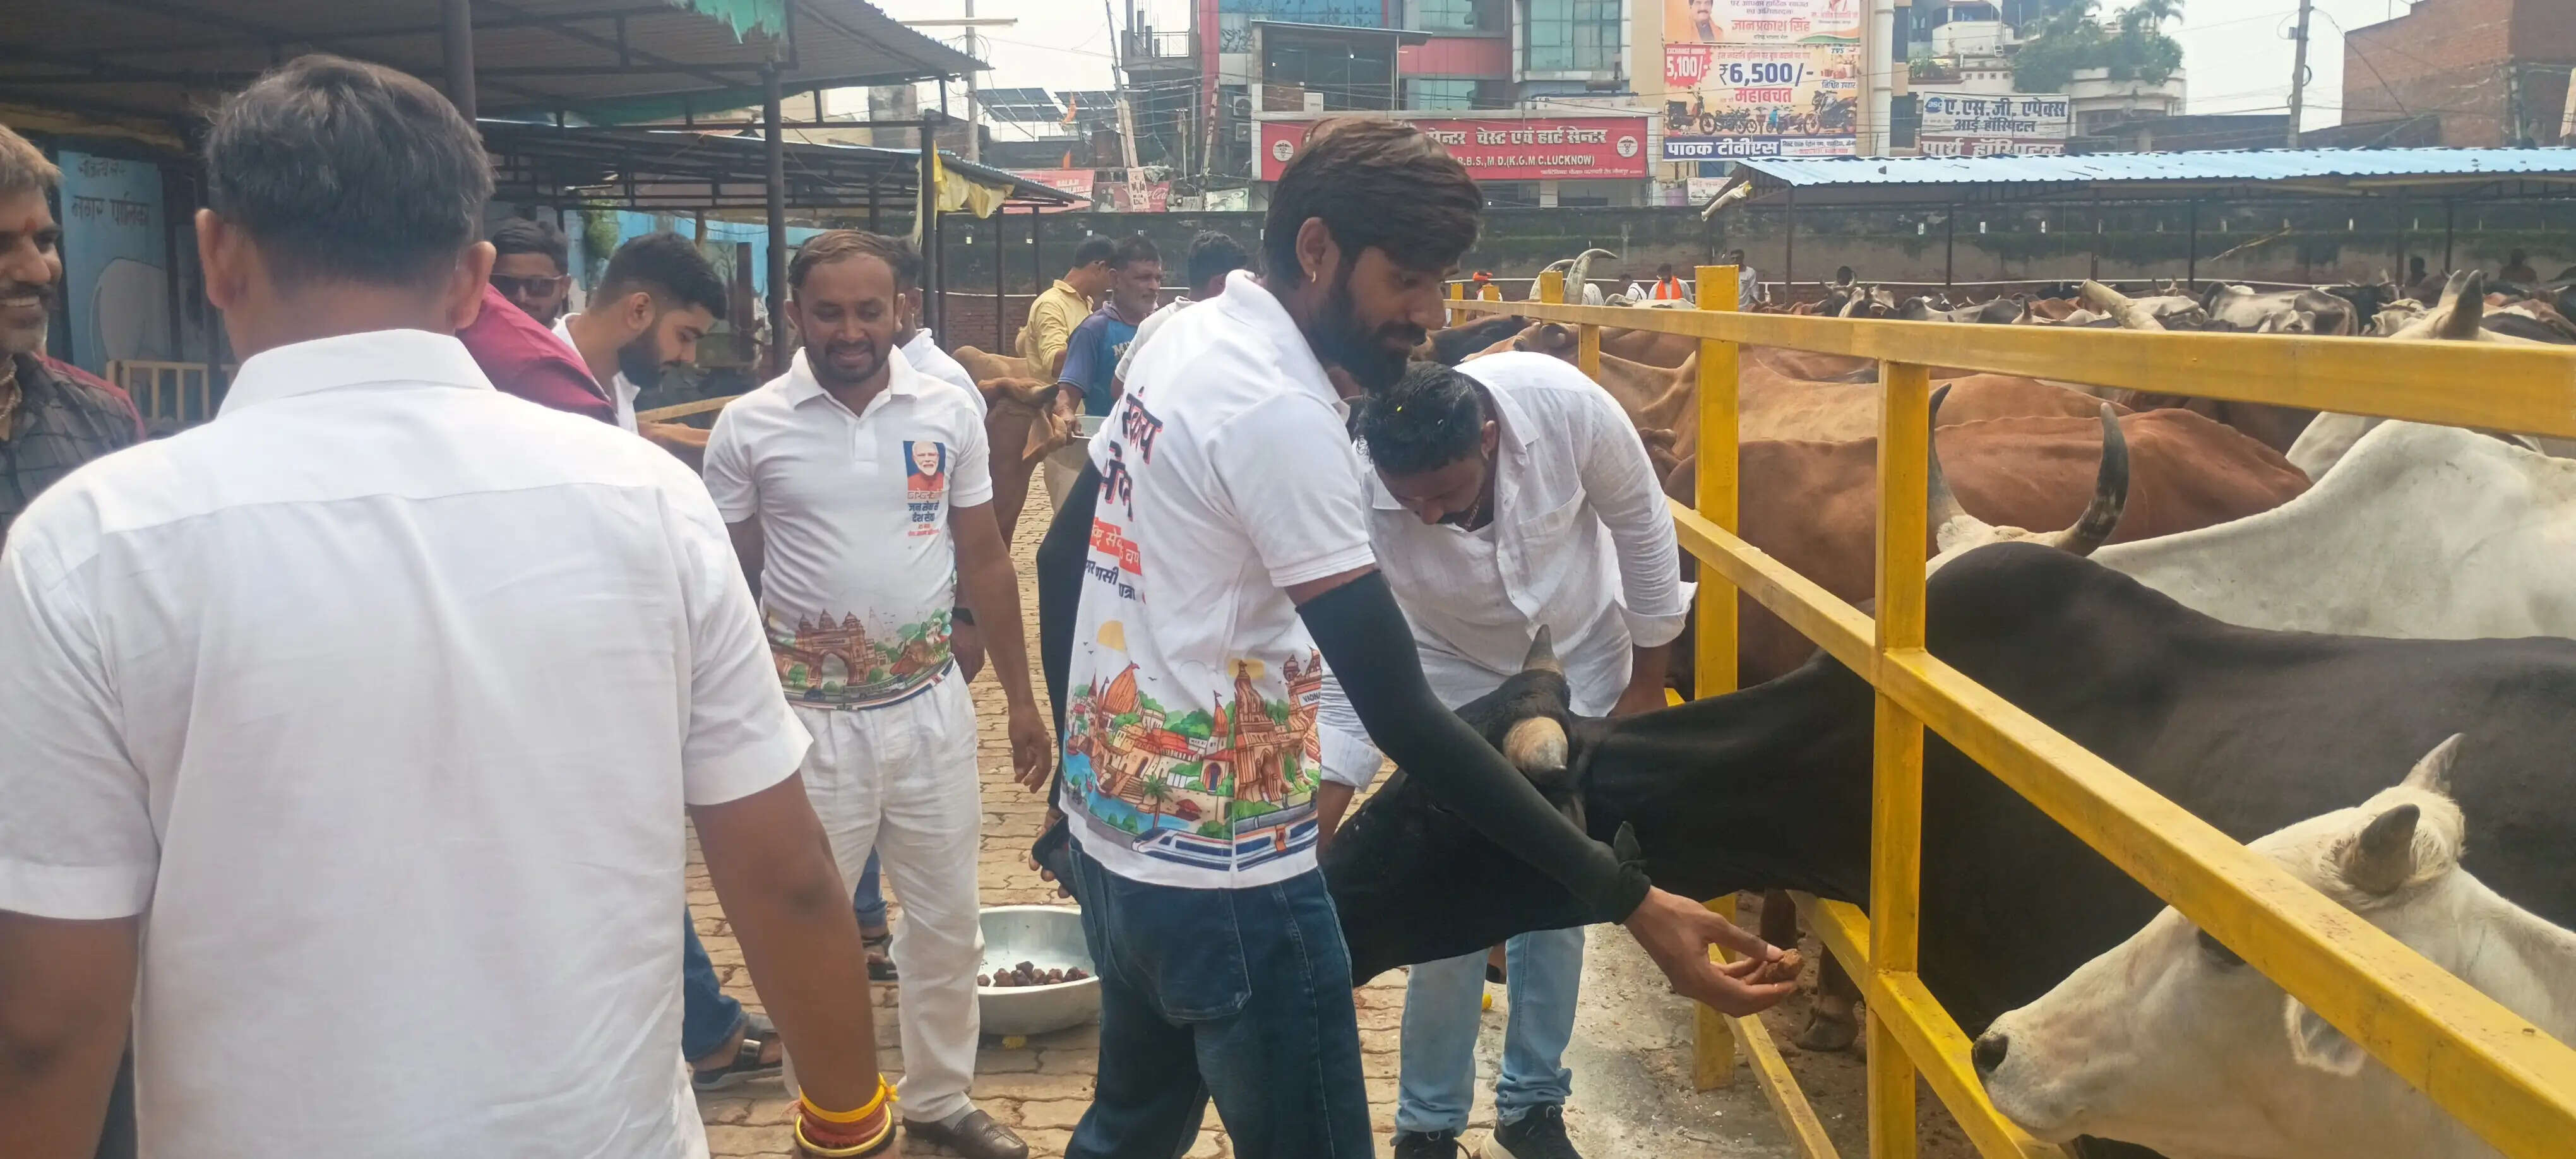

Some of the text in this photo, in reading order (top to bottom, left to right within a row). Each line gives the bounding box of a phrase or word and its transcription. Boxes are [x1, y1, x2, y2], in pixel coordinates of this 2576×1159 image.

[1789, 17, 1811, 32] सिंह
[1734, 88, 1792, 103] महाबचत
[1954, 117, 1980, 133] आई
[1509, 126, 1534, 144] एवं
[1536, 126, 1565, 144] हार्ट
[1566, 126, 1608, 144] सेन्टर
[1666, 142, 1714, 155] पाठक
[1715, 138, 1779, 155] टीवीएस
